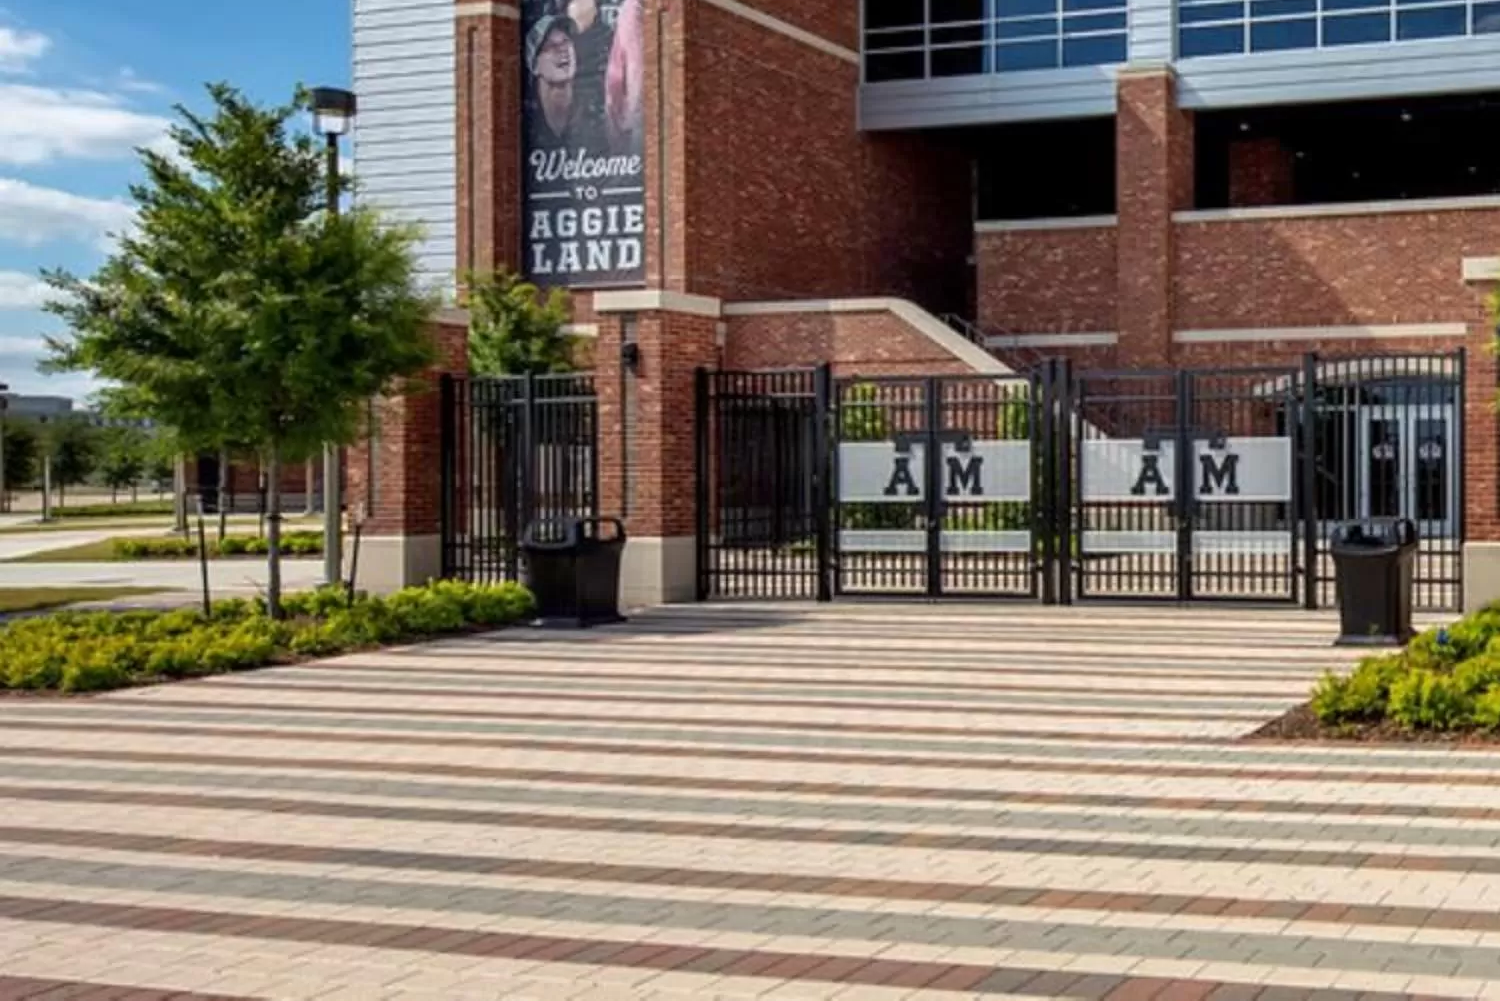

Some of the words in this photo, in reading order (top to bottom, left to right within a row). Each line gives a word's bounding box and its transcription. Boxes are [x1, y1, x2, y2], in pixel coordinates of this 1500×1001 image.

[529, 147, 642, 182] Welcome
[575, 185, 598, 200] TO
[529, 204, 644, 240] AGGIE
[532, 238, 641, 274] LAND
